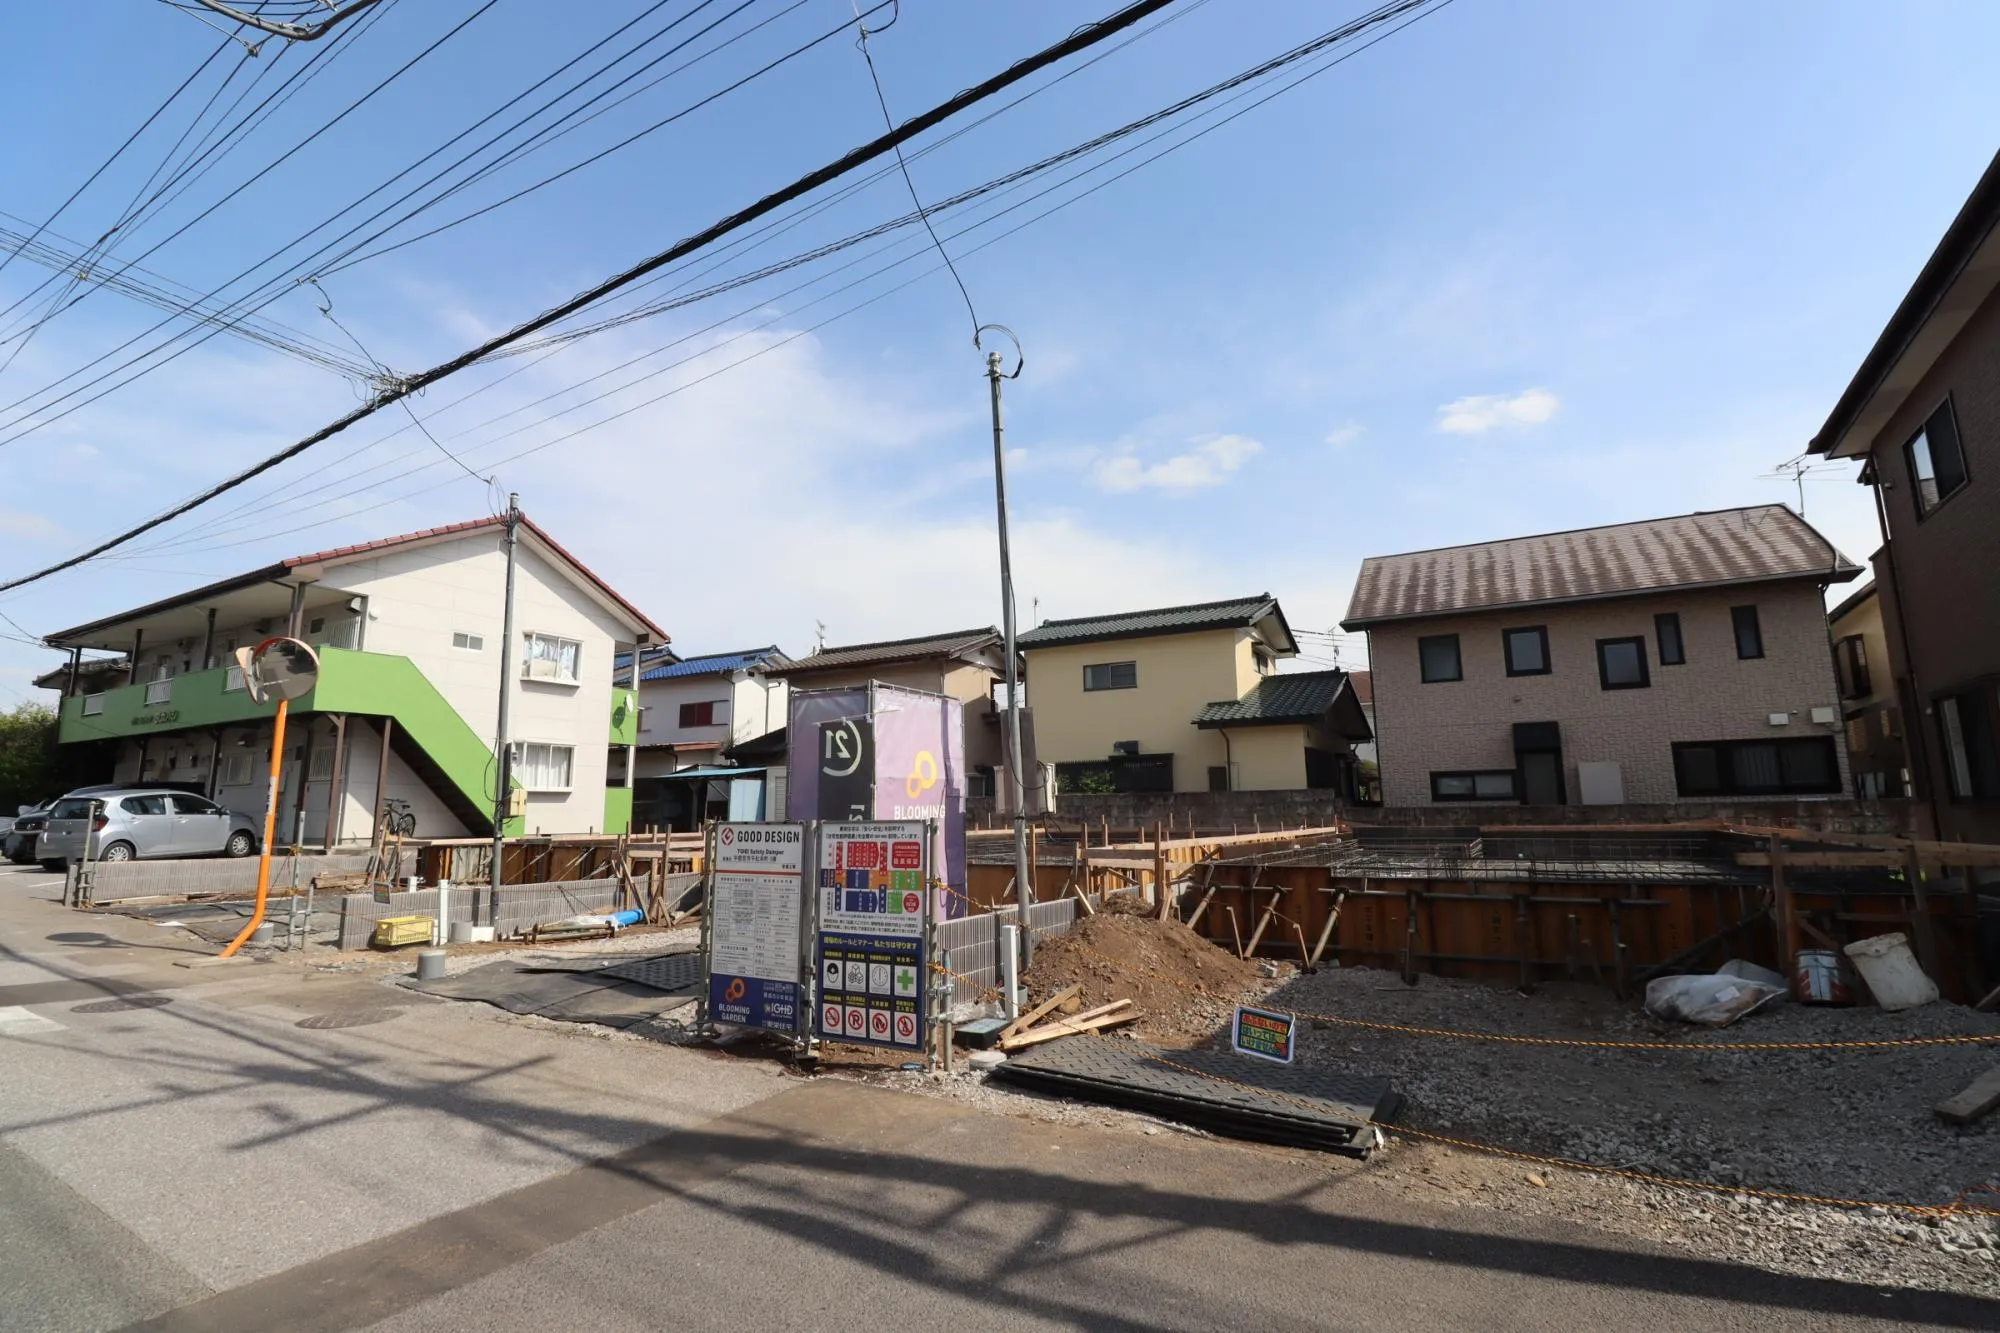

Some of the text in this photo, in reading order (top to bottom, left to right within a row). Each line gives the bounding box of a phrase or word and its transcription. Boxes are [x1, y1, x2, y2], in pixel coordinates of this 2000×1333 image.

[894, 805, 946, 819] BLOOMING
[737, 830, 800, 843] GOOD DESIGN
[718, 1003, 751, 1014] BLOOMING
[721, 1012, 747, 1023] GARDEN
